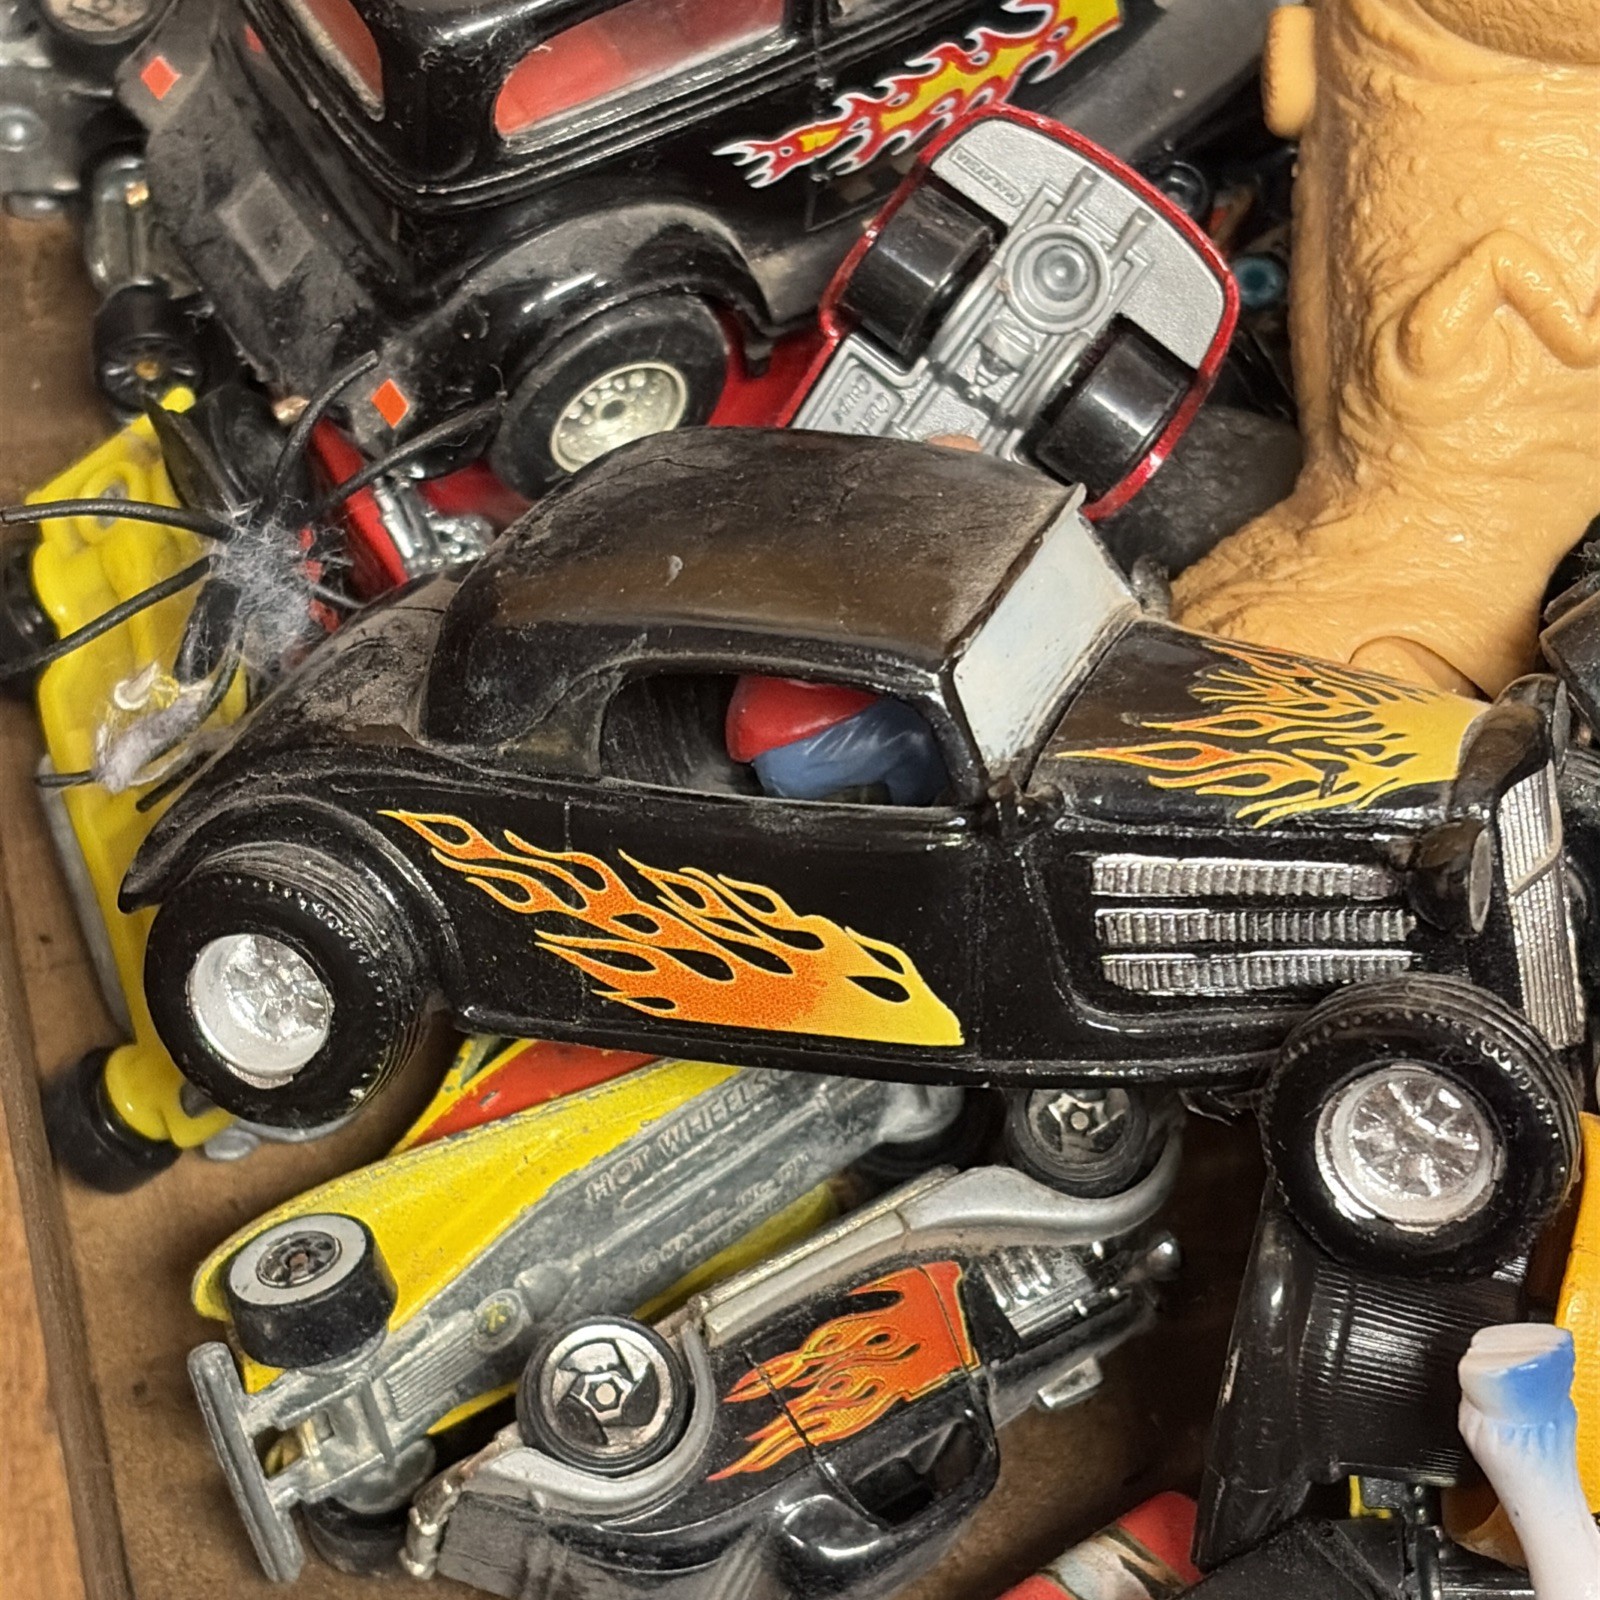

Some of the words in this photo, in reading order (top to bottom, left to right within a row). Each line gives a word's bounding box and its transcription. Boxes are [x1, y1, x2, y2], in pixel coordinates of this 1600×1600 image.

[956, 149, 1019, 202] MALAYSIA
[584, 1144, 651, 1203] HOT
[656, 1067, 771, 1159] WHEELS
